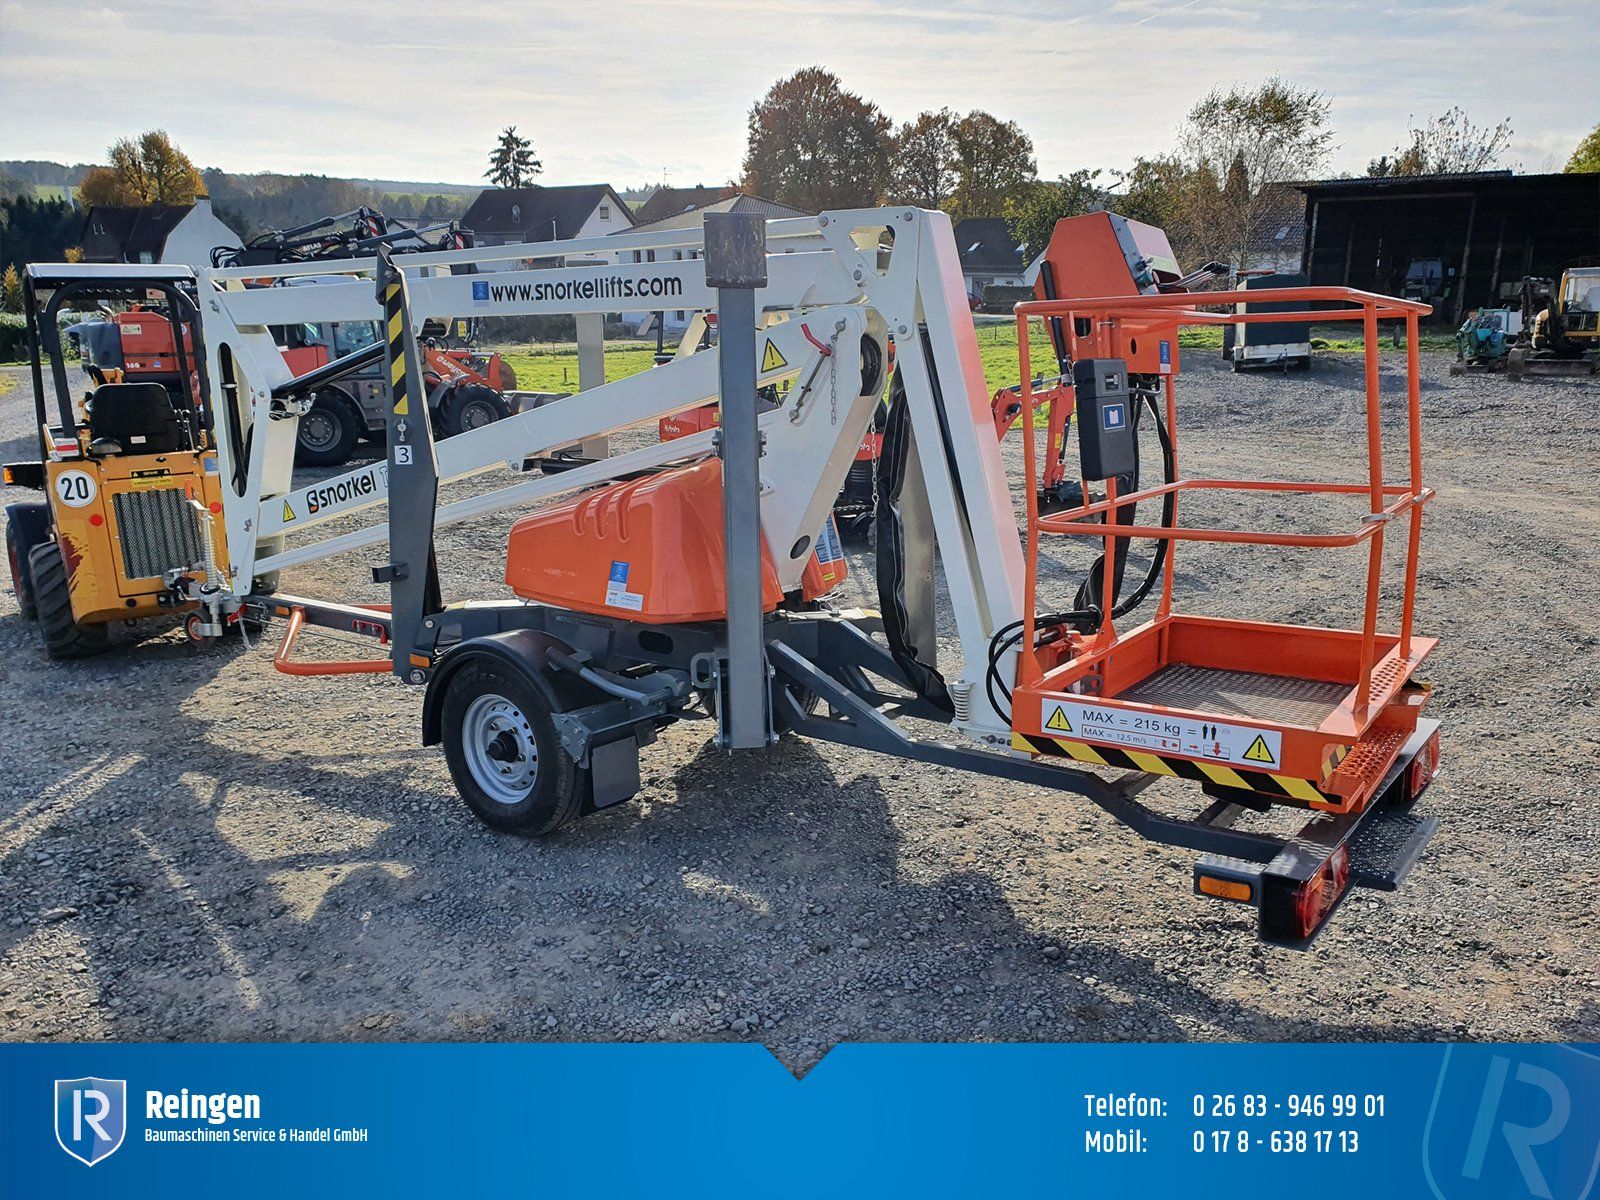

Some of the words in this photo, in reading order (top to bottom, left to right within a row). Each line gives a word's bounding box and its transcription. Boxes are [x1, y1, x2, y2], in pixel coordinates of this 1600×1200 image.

[490, 275, 683, 302] www.snorkellifts.com
[399, 447, 410, 463] 3
[60, 476, 89, 501] 20
[318, 470, 378, 508] snorkel
[1082, 710, 1114, 725] MAX
[1134, 718, 1160, 731] 215
[1164, 722, 1181, 737] kg
[1084, 728, 1105, 738] MAX
[1116, 732, 1132, 742] 12.5
[1132, 736, 1147, 745] m/s
